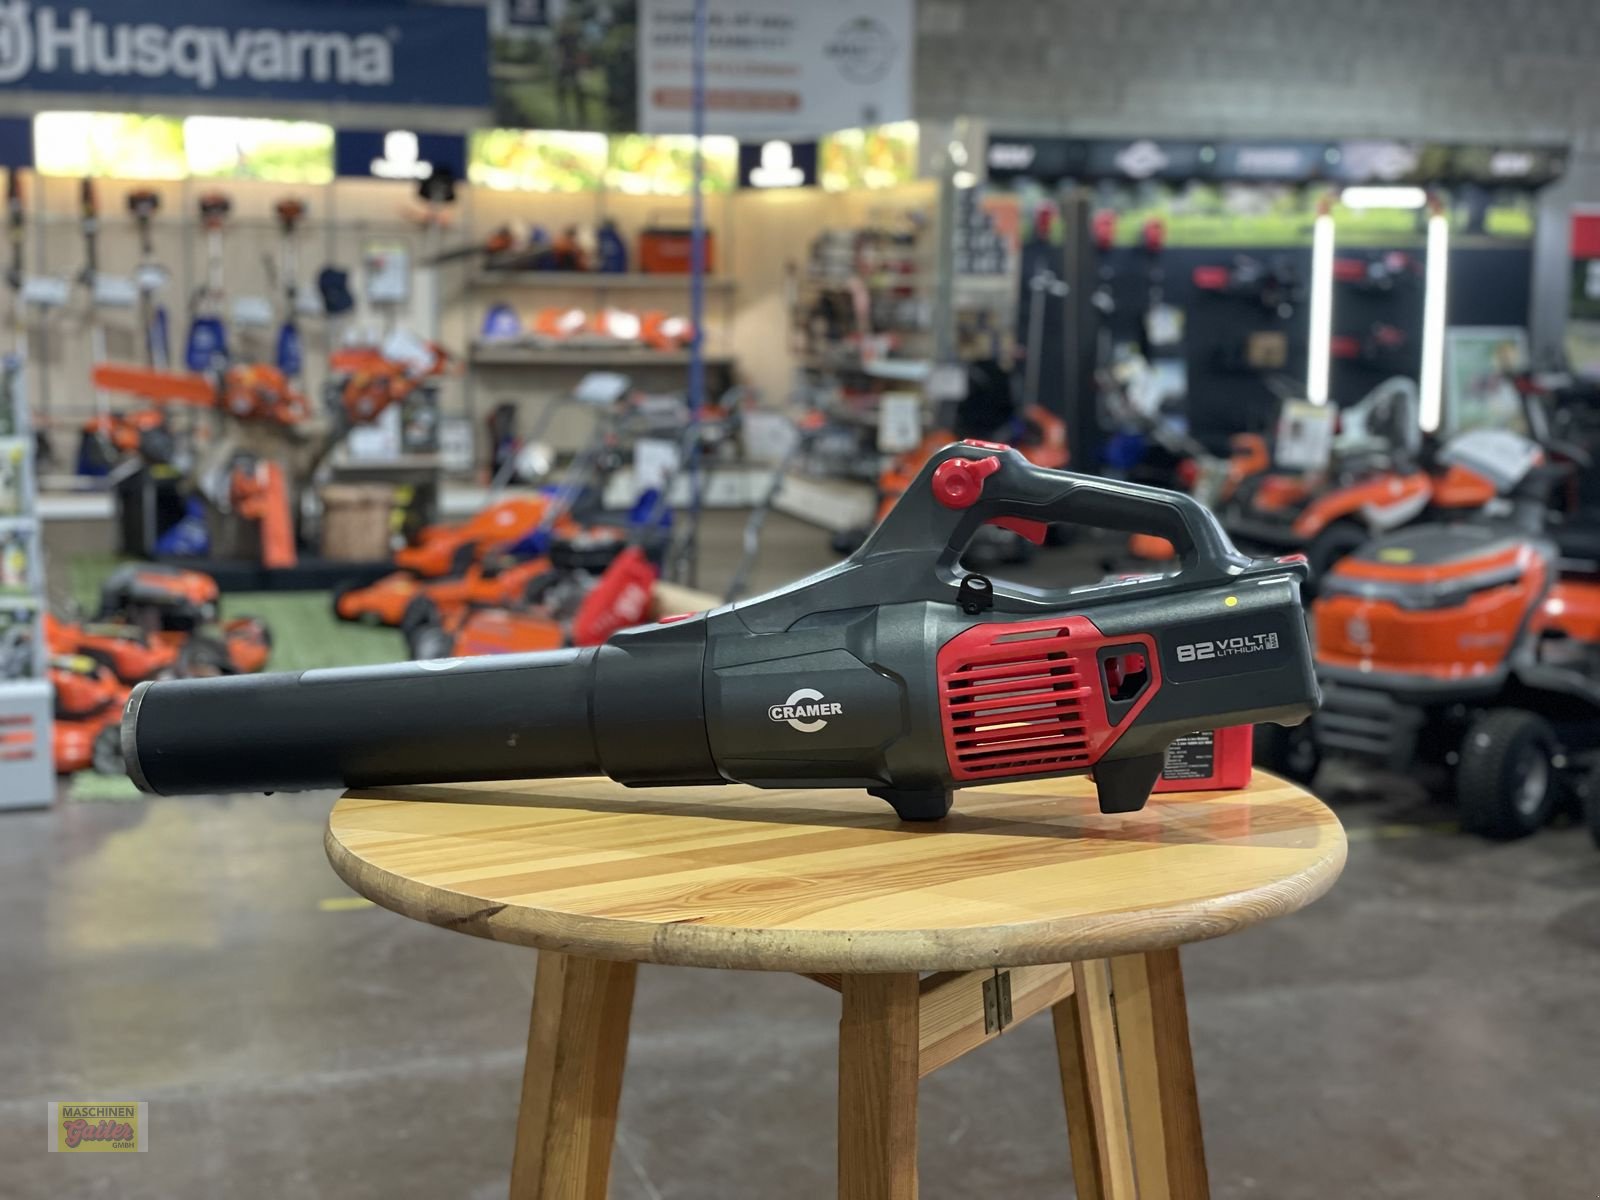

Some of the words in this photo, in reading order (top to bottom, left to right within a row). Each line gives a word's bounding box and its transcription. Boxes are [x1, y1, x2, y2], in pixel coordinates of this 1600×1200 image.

[35, 7, 393, 89] Husqvarna
[1176, 642, 1216, 662] 82
[1216, 634, 1268, 650] VOLT
[1217, 645, 1264, 657] LITHIUM
[771, 702, 843, 719] CRAMER
